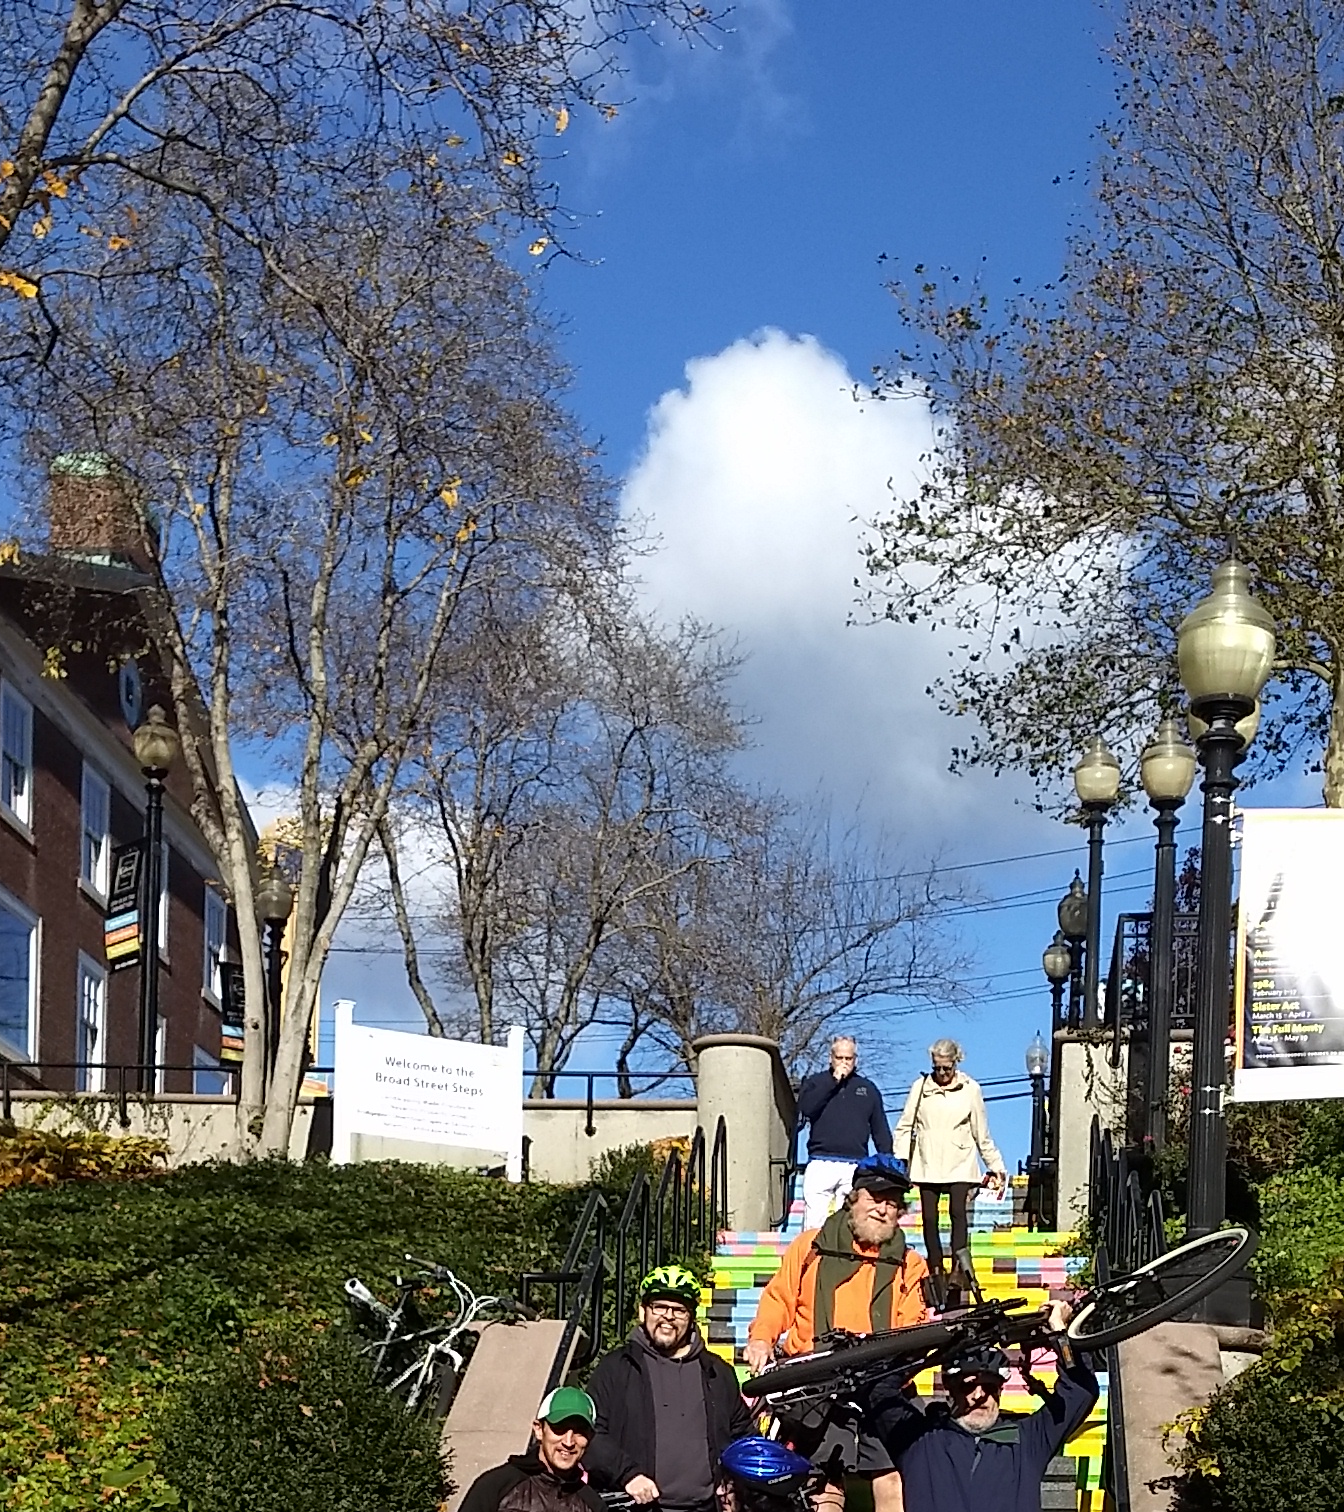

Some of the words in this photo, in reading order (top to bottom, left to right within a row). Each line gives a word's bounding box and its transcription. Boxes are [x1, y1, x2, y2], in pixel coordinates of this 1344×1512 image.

[1252, 1002, 1281, 1012] Sister
[1282, 1001, 1300, 1010] Act
[1288, 1011, 1306, 1019] April
[1252, 1025, 1271, 1034] The
[1273, 1024, 1291, 1034] Full
[1292, 1023, 1325, 1034] Monty
[1284, 1035, 1299, 1043] May
[385, 1056, 438, 1072] Welcome
[441, 1065, 452, 1075] to
[456, 1066, 475, 1078] the
[375, 1072, 410, 1086] Broad
[413, 1077, 448, 1091] Street
[452, 1083, 484, 1097] Steps
